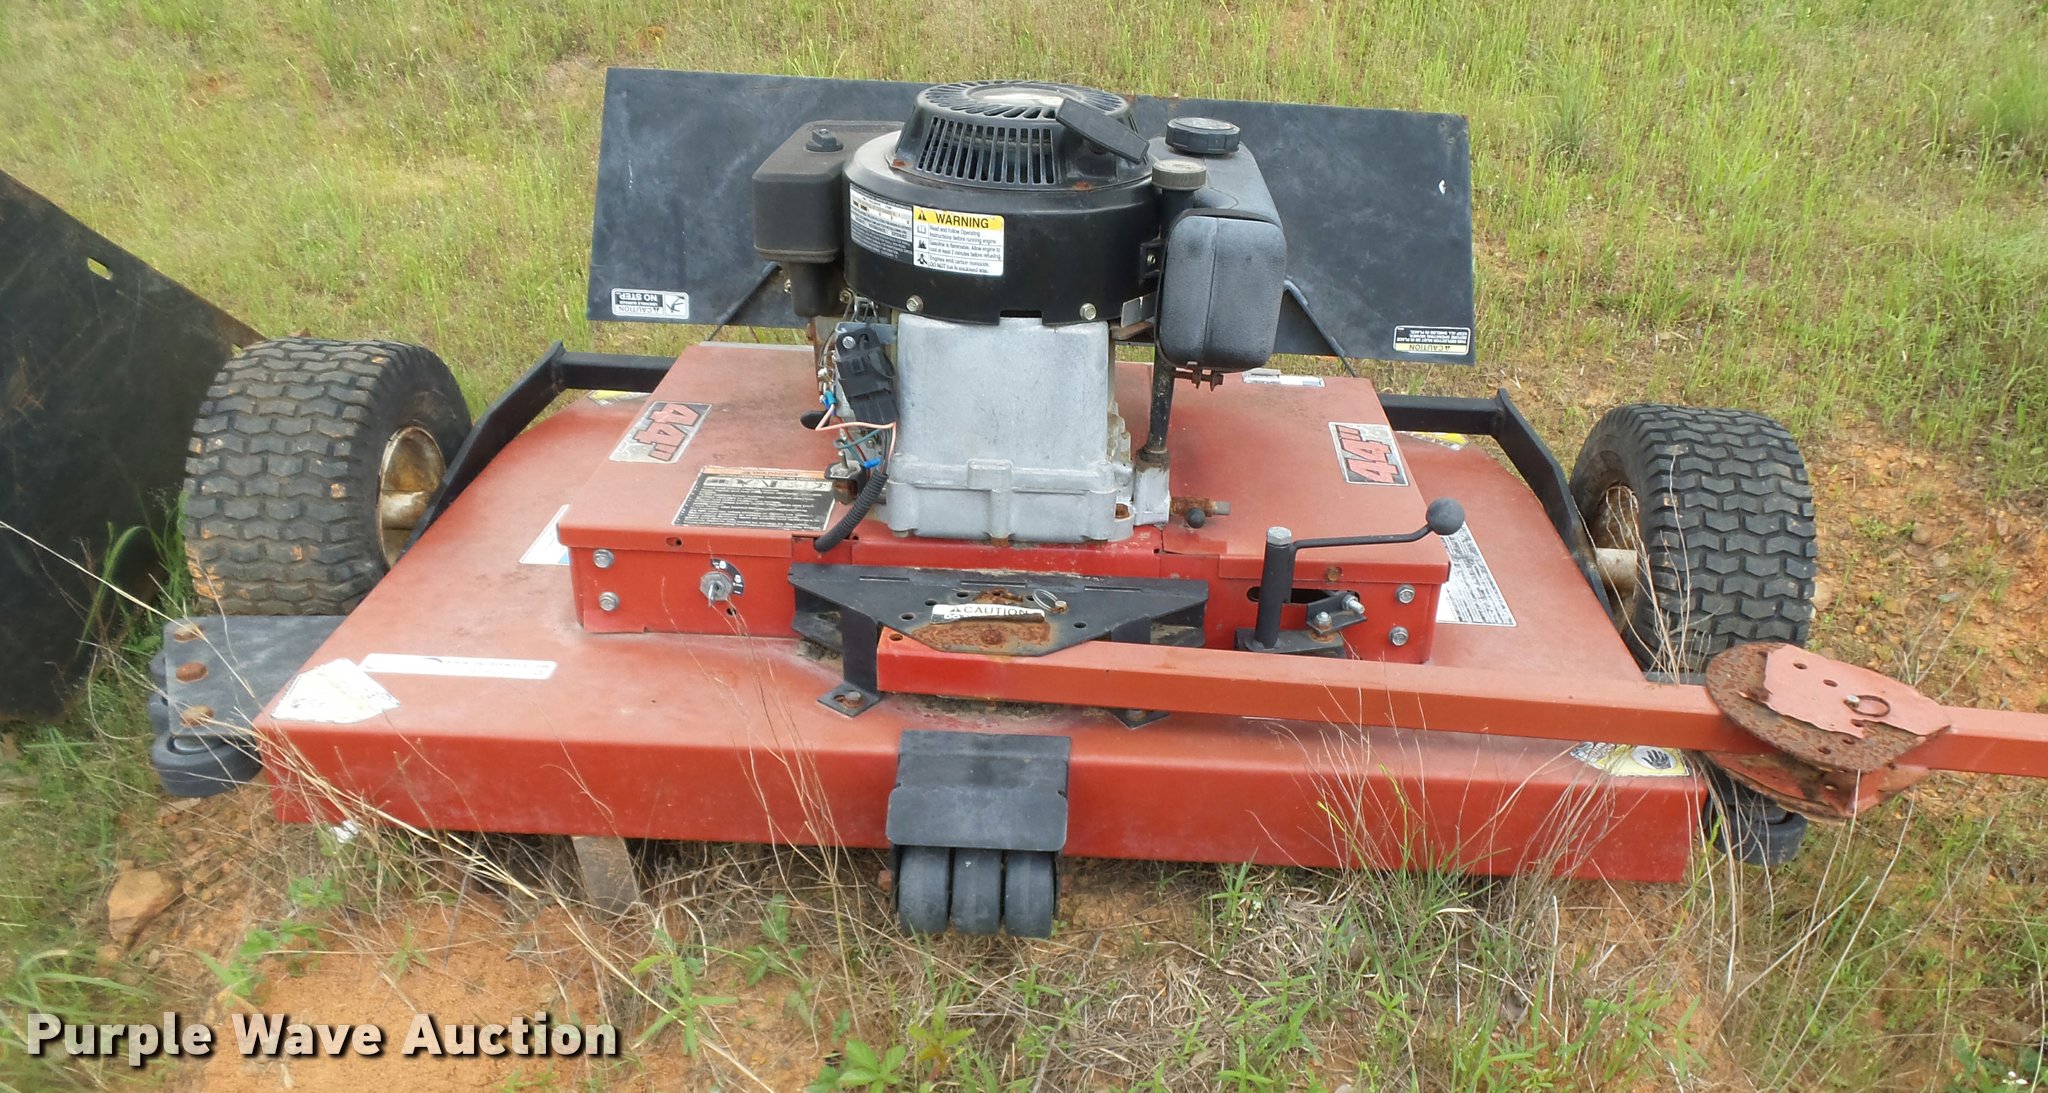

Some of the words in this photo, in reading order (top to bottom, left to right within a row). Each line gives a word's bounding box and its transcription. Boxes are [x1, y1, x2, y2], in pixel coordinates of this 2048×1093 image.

[936, 213, 989, 229] WARNING
[619, 293, 642, 301] STEP
[643, 294, 658, 302] NO
[632, 402, 701, 461] 44"
[1335, 425, 1399, 484] 44"
[964, 606, 1029, 616] CAUTION
